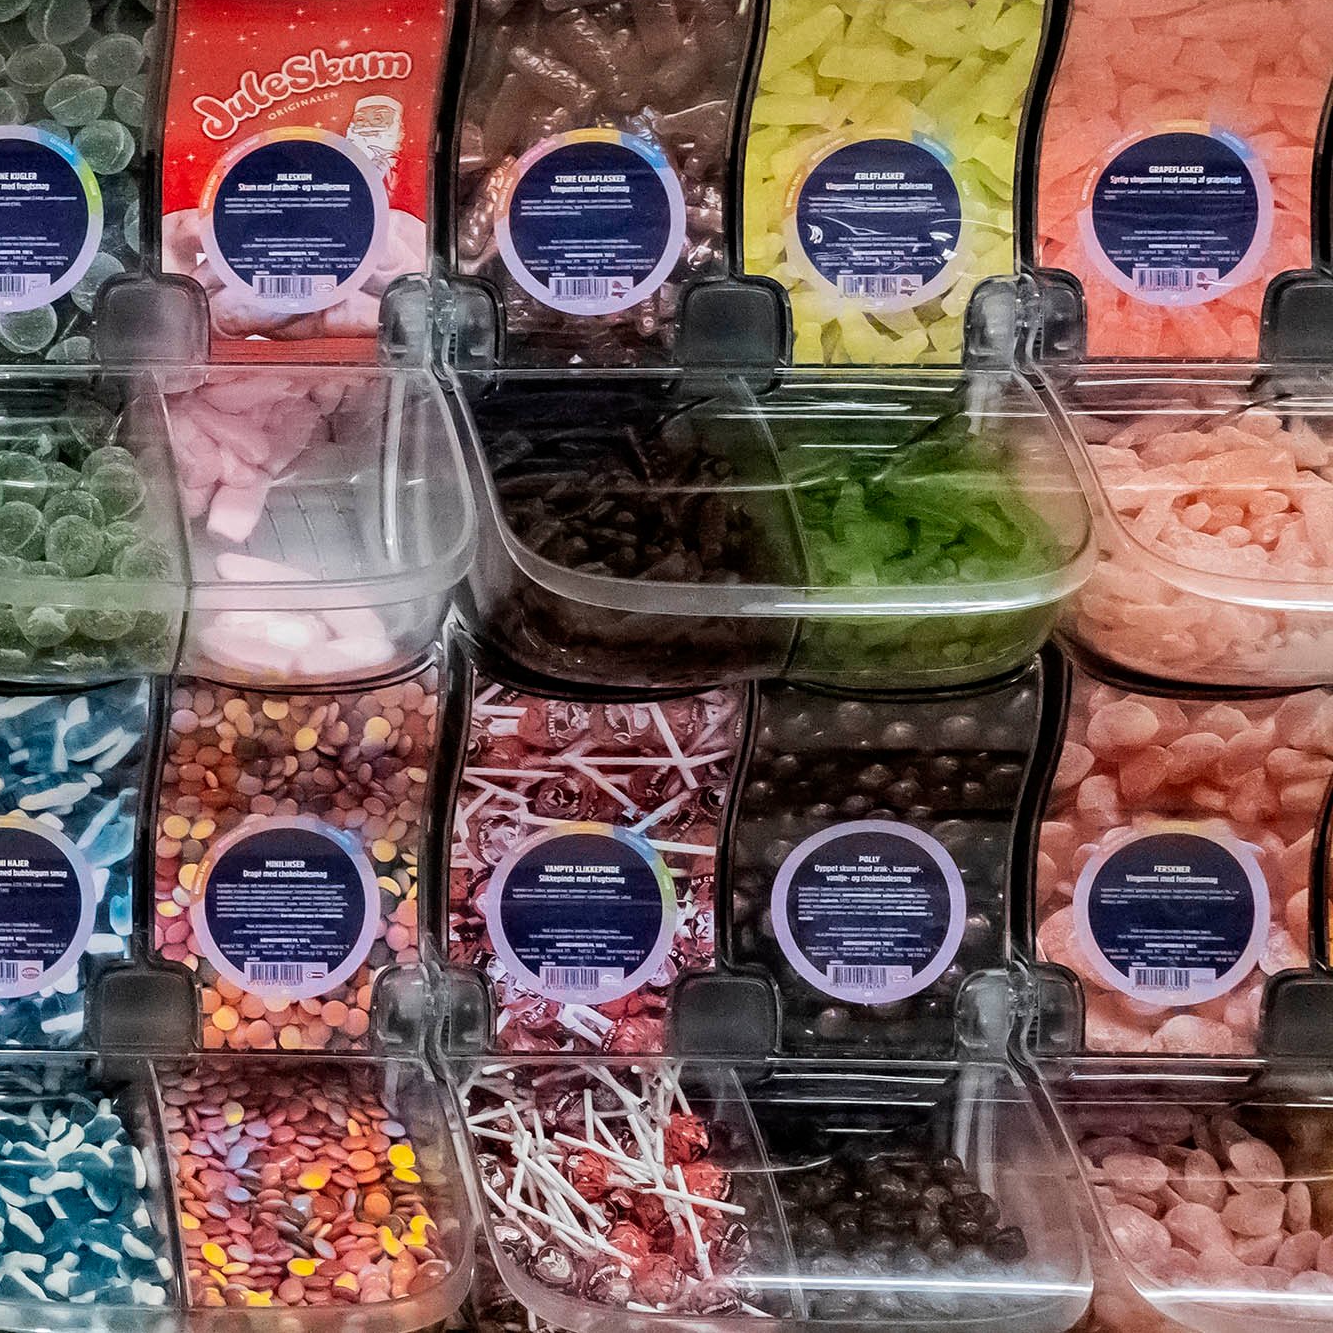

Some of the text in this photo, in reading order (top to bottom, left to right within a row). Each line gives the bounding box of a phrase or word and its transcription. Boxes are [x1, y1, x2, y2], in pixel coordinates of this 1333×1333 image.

[193, 49, 412, 140] JuleSkum
[1149, 165, 1203, 174] GRAPEFLASKER
[10, 172, 37, 181] KUGLER
[555, 175, 625, 183] STORE COLAFLASKER
[855, 172, 904, 181] ÆBLEFLASKER
[7, 858, 29, 867] HAJER
[859, 855, 880, 863] POLLY
[545, 865, 619, 874] VAMPYR SLIKKEPINDE
